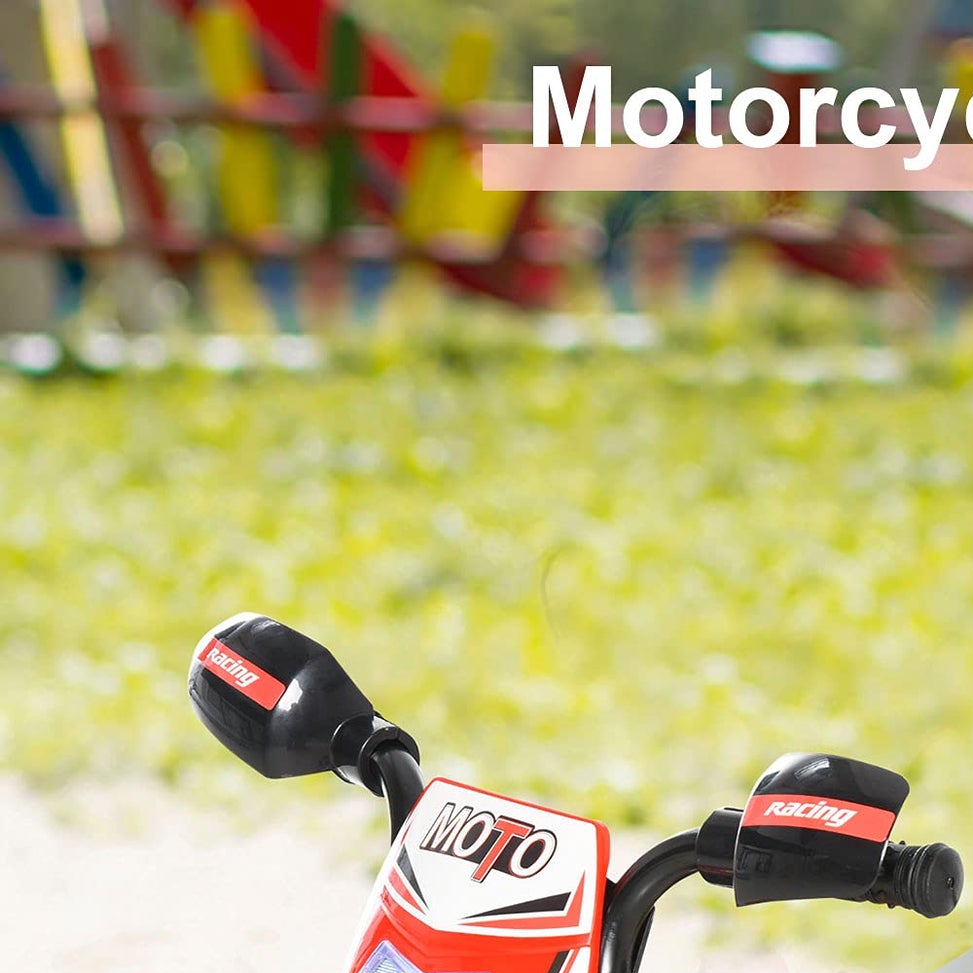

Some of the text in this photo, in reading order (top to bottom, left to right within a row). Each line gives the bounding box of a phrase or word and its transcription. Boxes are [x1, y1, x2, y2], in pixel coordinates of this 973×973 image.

[207, 647, 260, 688] Racing
[763, 801, 858, 828] Racing
[419, 801, 558, 883] MOTO
